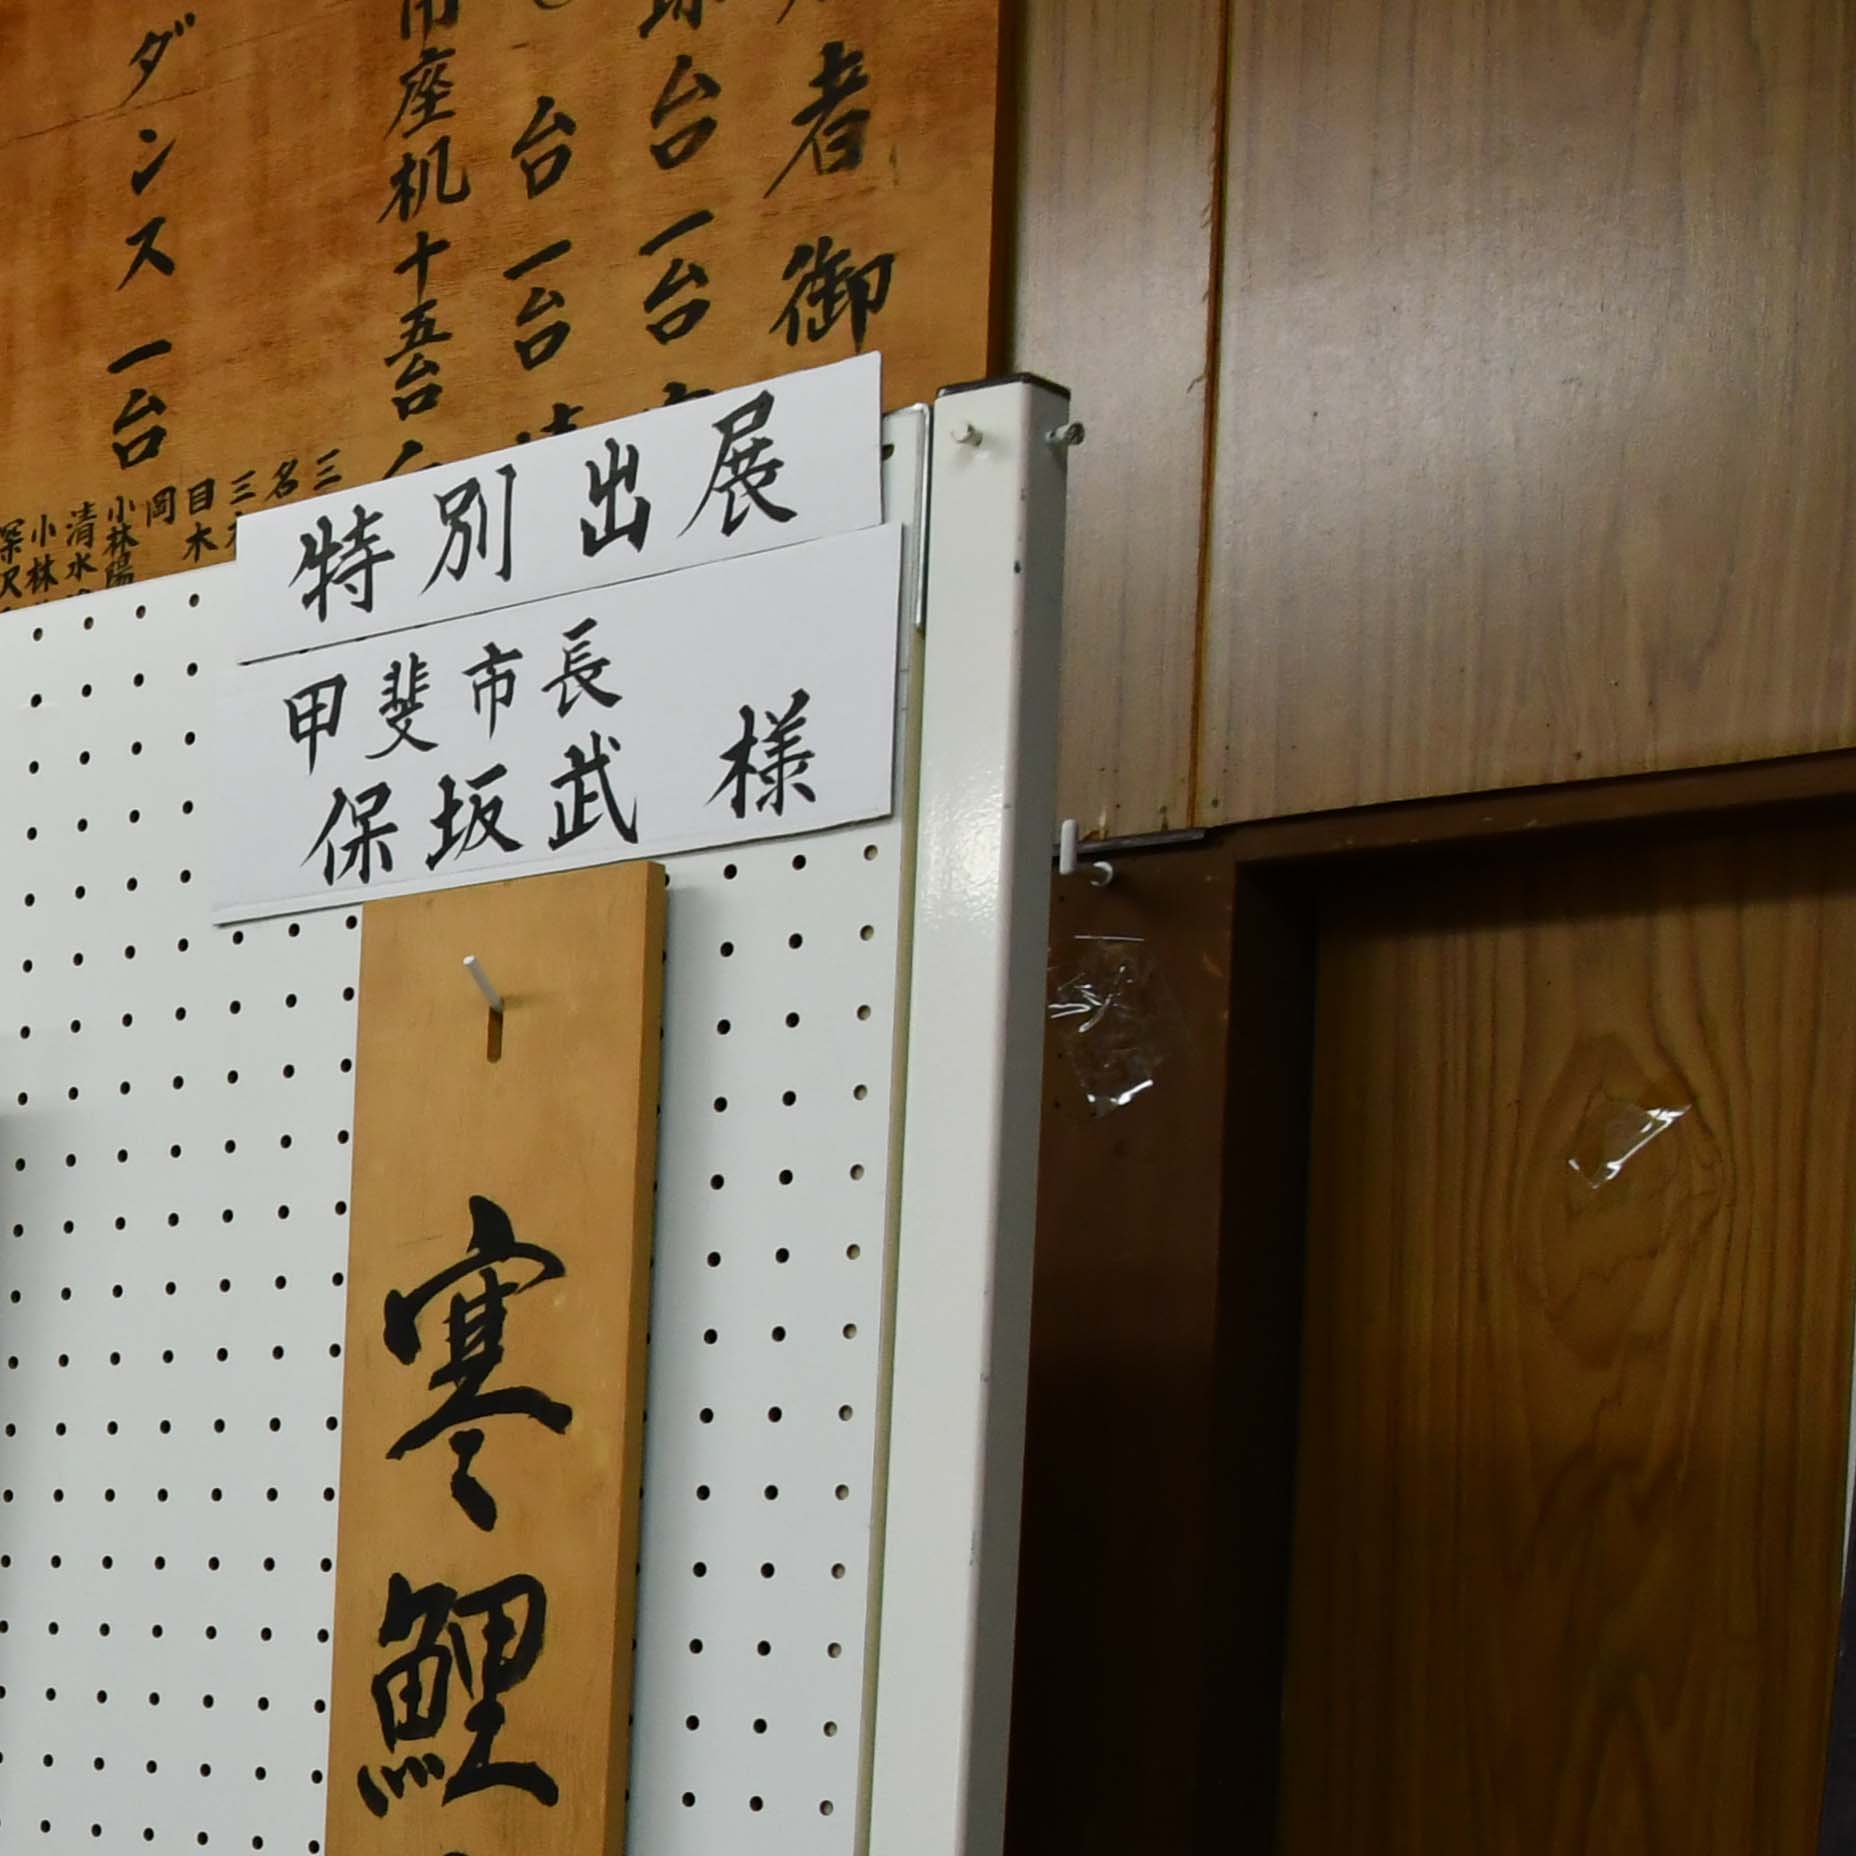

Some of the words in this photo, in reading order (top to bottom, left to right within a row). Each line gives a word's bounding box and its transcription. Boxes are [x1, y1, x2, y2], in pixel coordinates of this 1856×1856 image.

[116, 14, 194, 291] ダンス
[108, 338, 172, 470] 一台
[289, 390, 799, 623] 特別出展
[282, 617, 625, 776] 甲斐市長
[300, 731, 640, 886] 保坂武
[705, 688, 818, 821] 様
